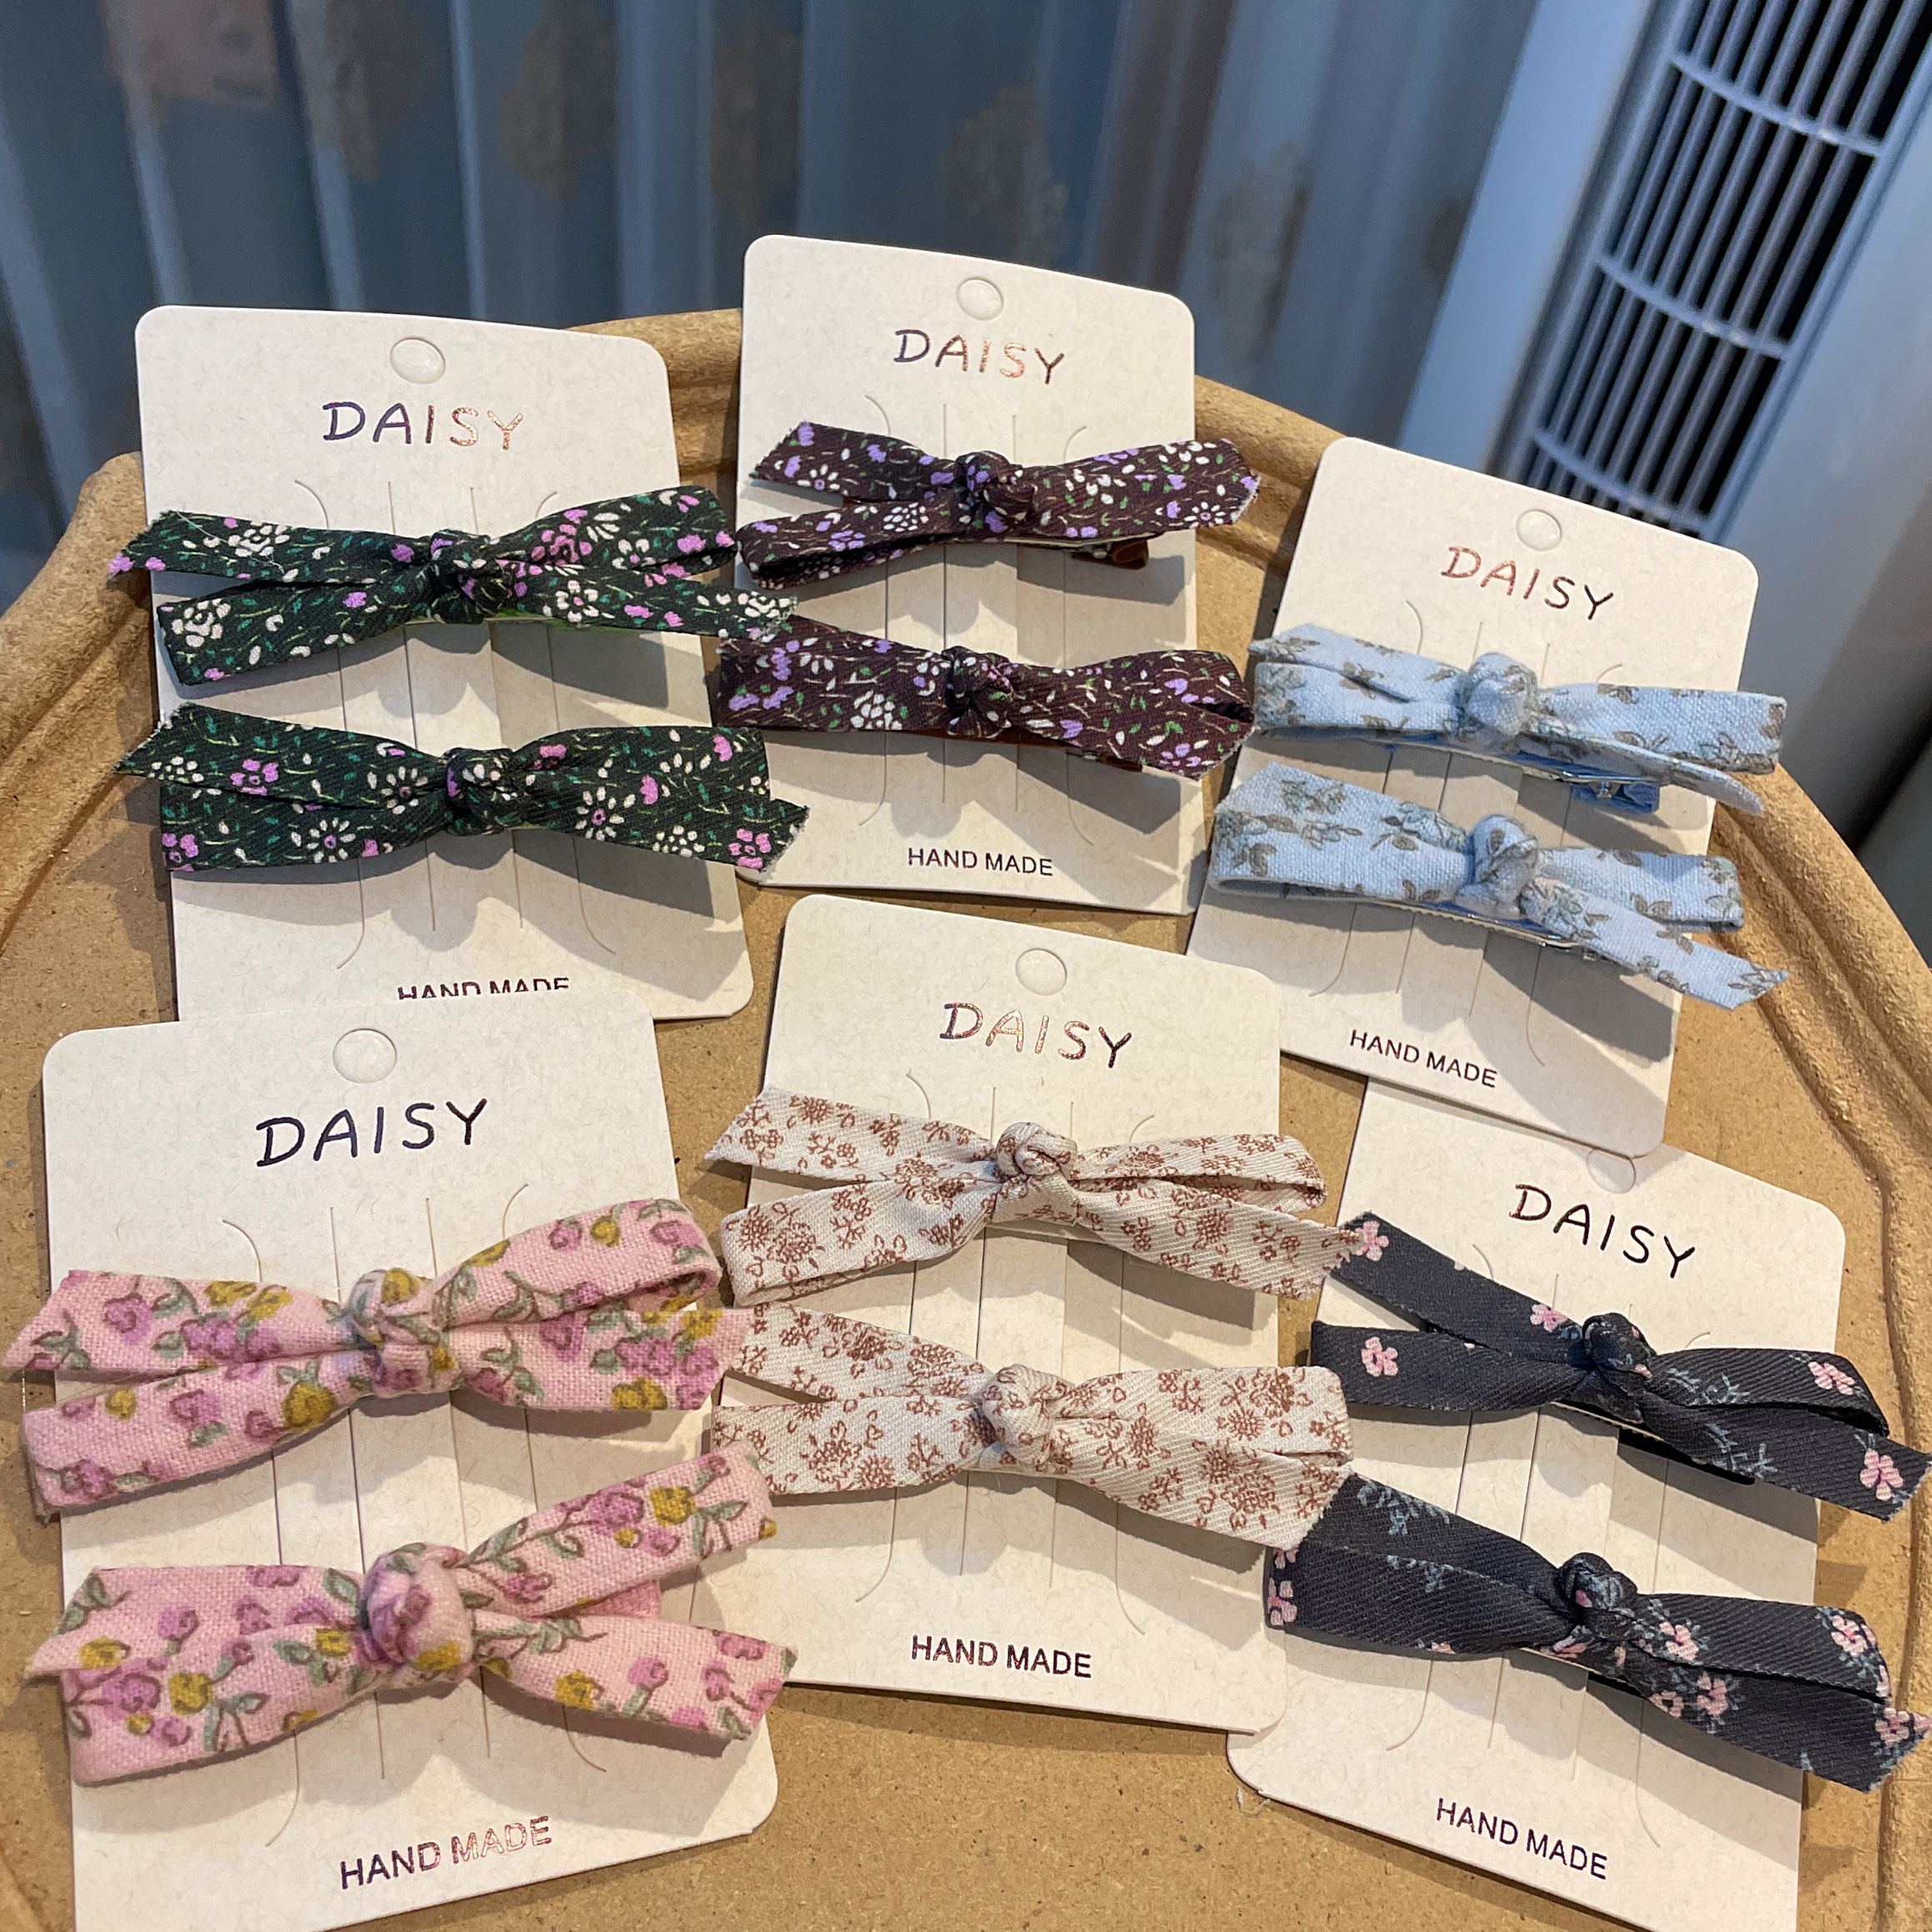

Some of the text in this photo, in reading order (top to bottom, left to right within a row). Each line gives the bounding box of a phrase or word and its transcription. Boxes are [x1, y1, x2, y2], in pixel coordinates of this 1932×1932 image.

[893, 329, 1065, 385] DAISY
[322, 400, 524, 451] DAISY
[1440, 546, 1614, 621] DAISY
[908, 847, 1054, 877] HAND MADE
[397, 977, 570, 1000] HAND MADE
[938, 1002, 1133, 1069] DAISY
[1349, 1029, 1498, 1089] HAND MADE
[255, 1097, 488, 1168] DAISY
[1507, 1183, 1696, 1279] DAISY
[911, 1634, 1093, 1679] HAND MADE
[340, 1814, 552, 1890] HAND MADE
[1436, 1797, 1608, 1880] HAND MADE
